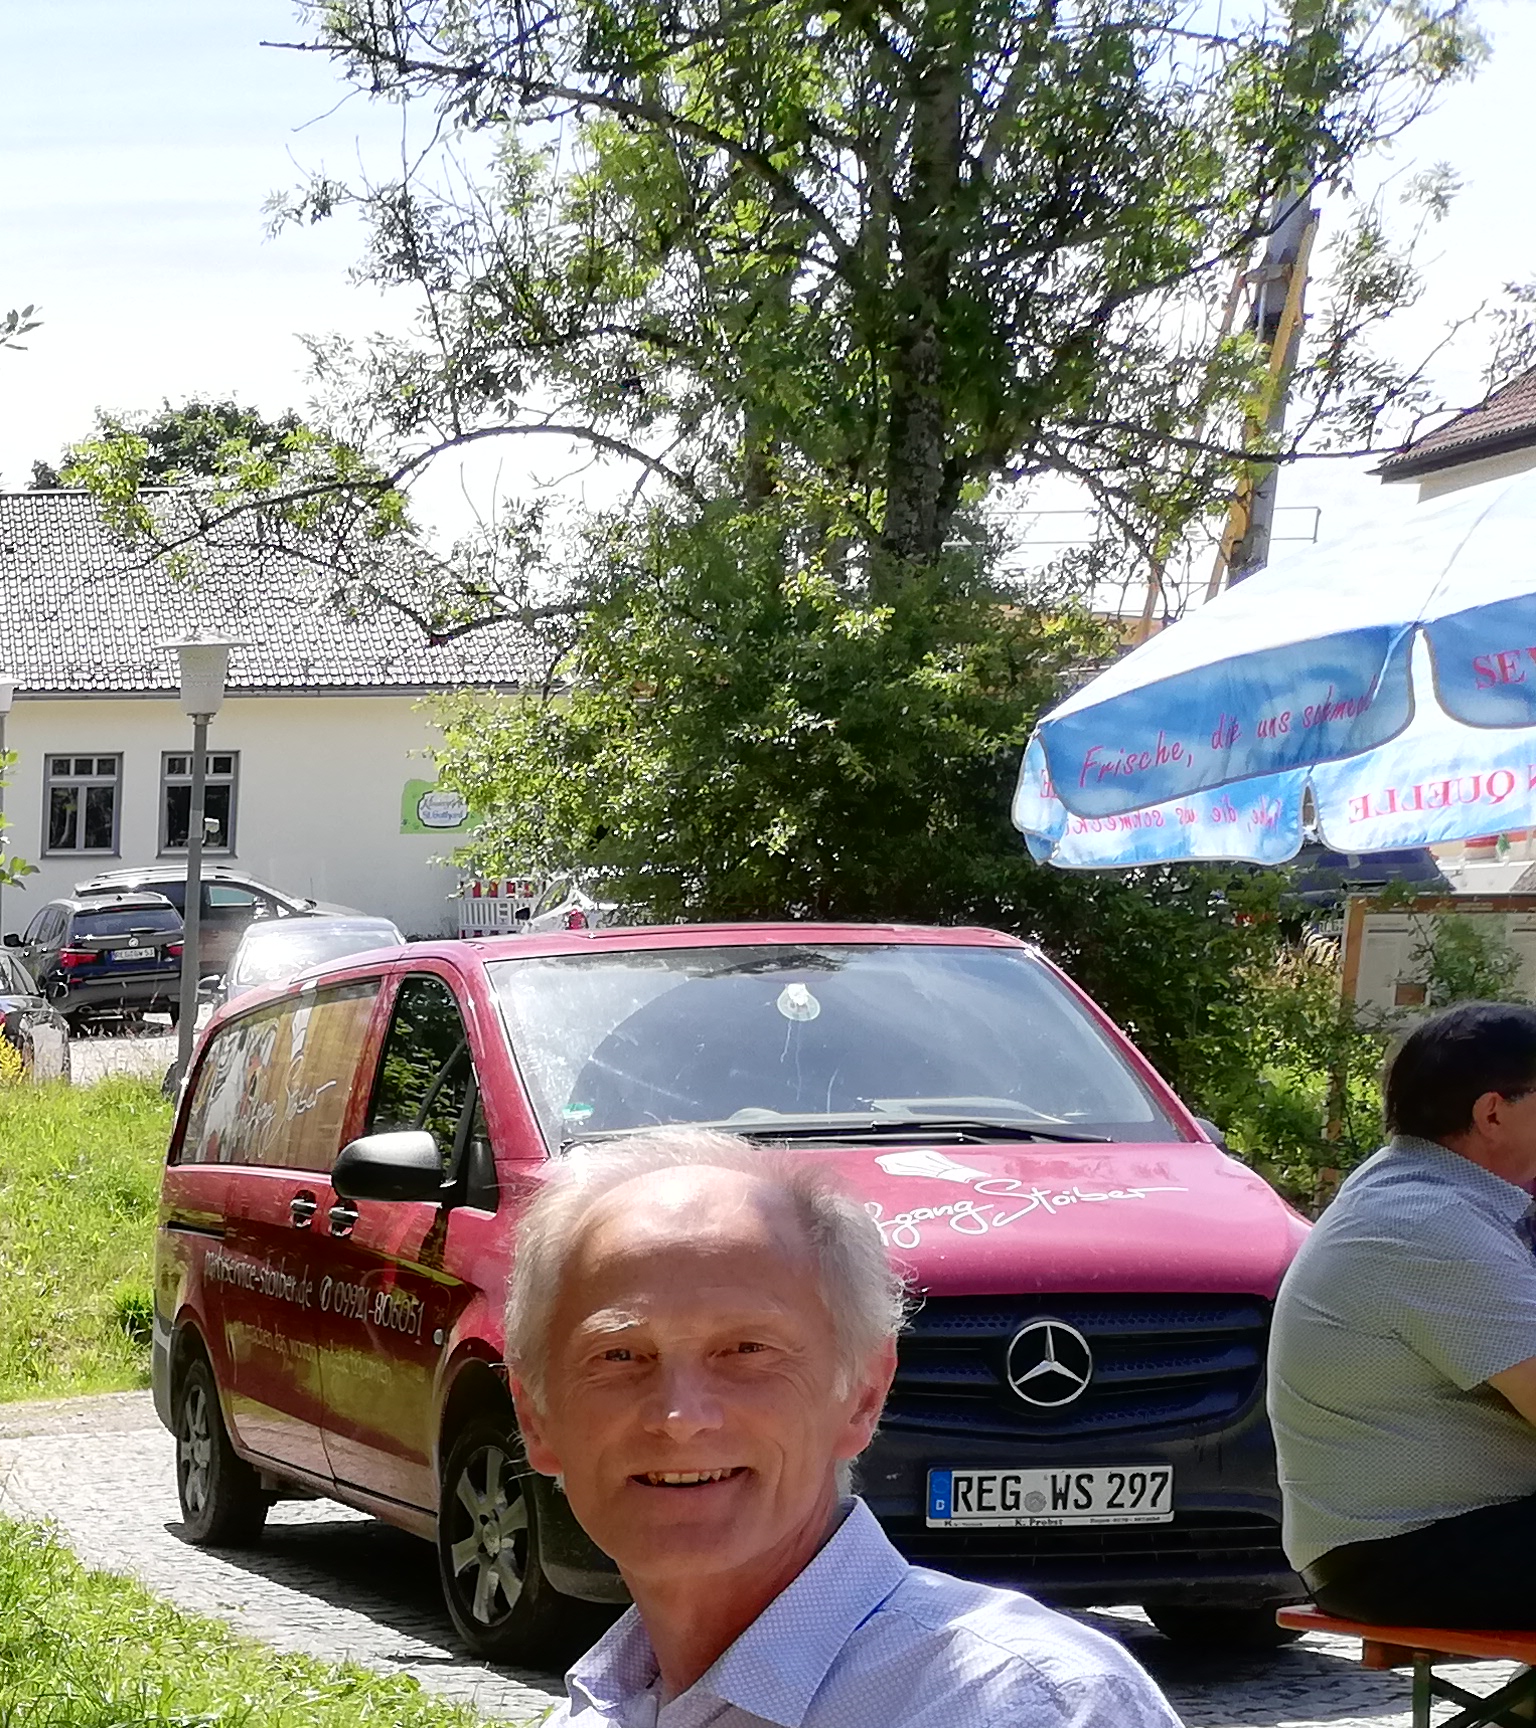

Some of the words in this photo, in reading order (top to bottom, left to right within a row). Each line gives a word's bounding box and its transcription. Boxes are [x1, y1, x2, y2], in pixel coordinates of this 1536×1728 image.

[1079, 731, 1194, 787] Frische,
[1211, 714, 1242, 750] die
[1257, 711, 1291, 739] uns
[974, 1178, 1189, 1227] Stoiber
[953, 1475, 1022, 1512] REG
[1050, 1473, 1094, 1510] WS
[1106, 1471, 1170, 1509] 297
